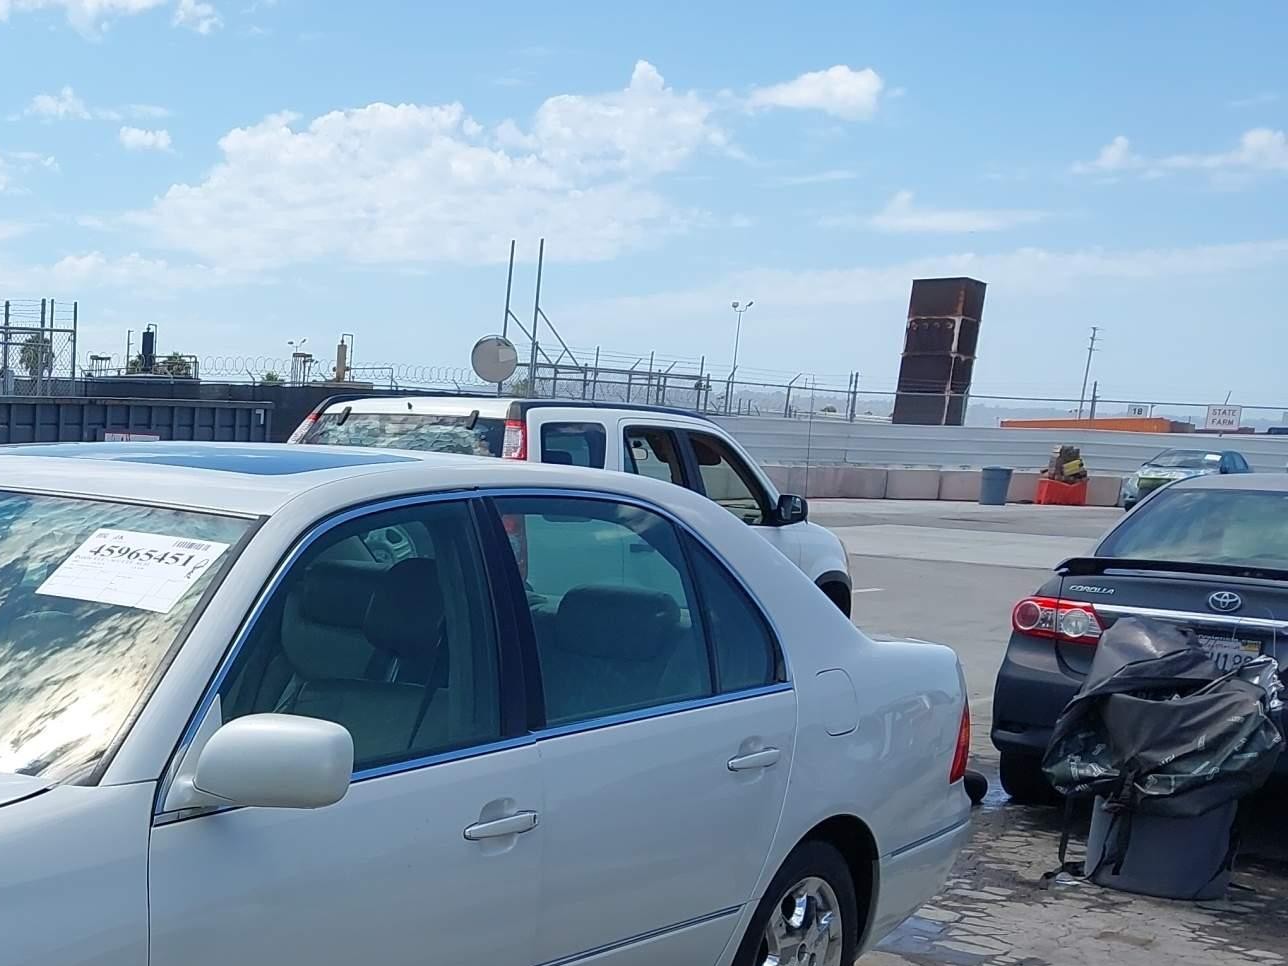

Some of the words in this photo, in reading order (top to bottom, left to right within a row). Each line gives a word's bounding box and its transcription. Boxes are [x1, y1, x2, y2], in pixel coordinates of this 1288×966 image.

[1212, 409, 1237, 417] STATE
[1212, 418, 1234, 426] FARM
[89, 544, 195, 567] 45965451
[1069, 585, 1114, 595] COROLLA
